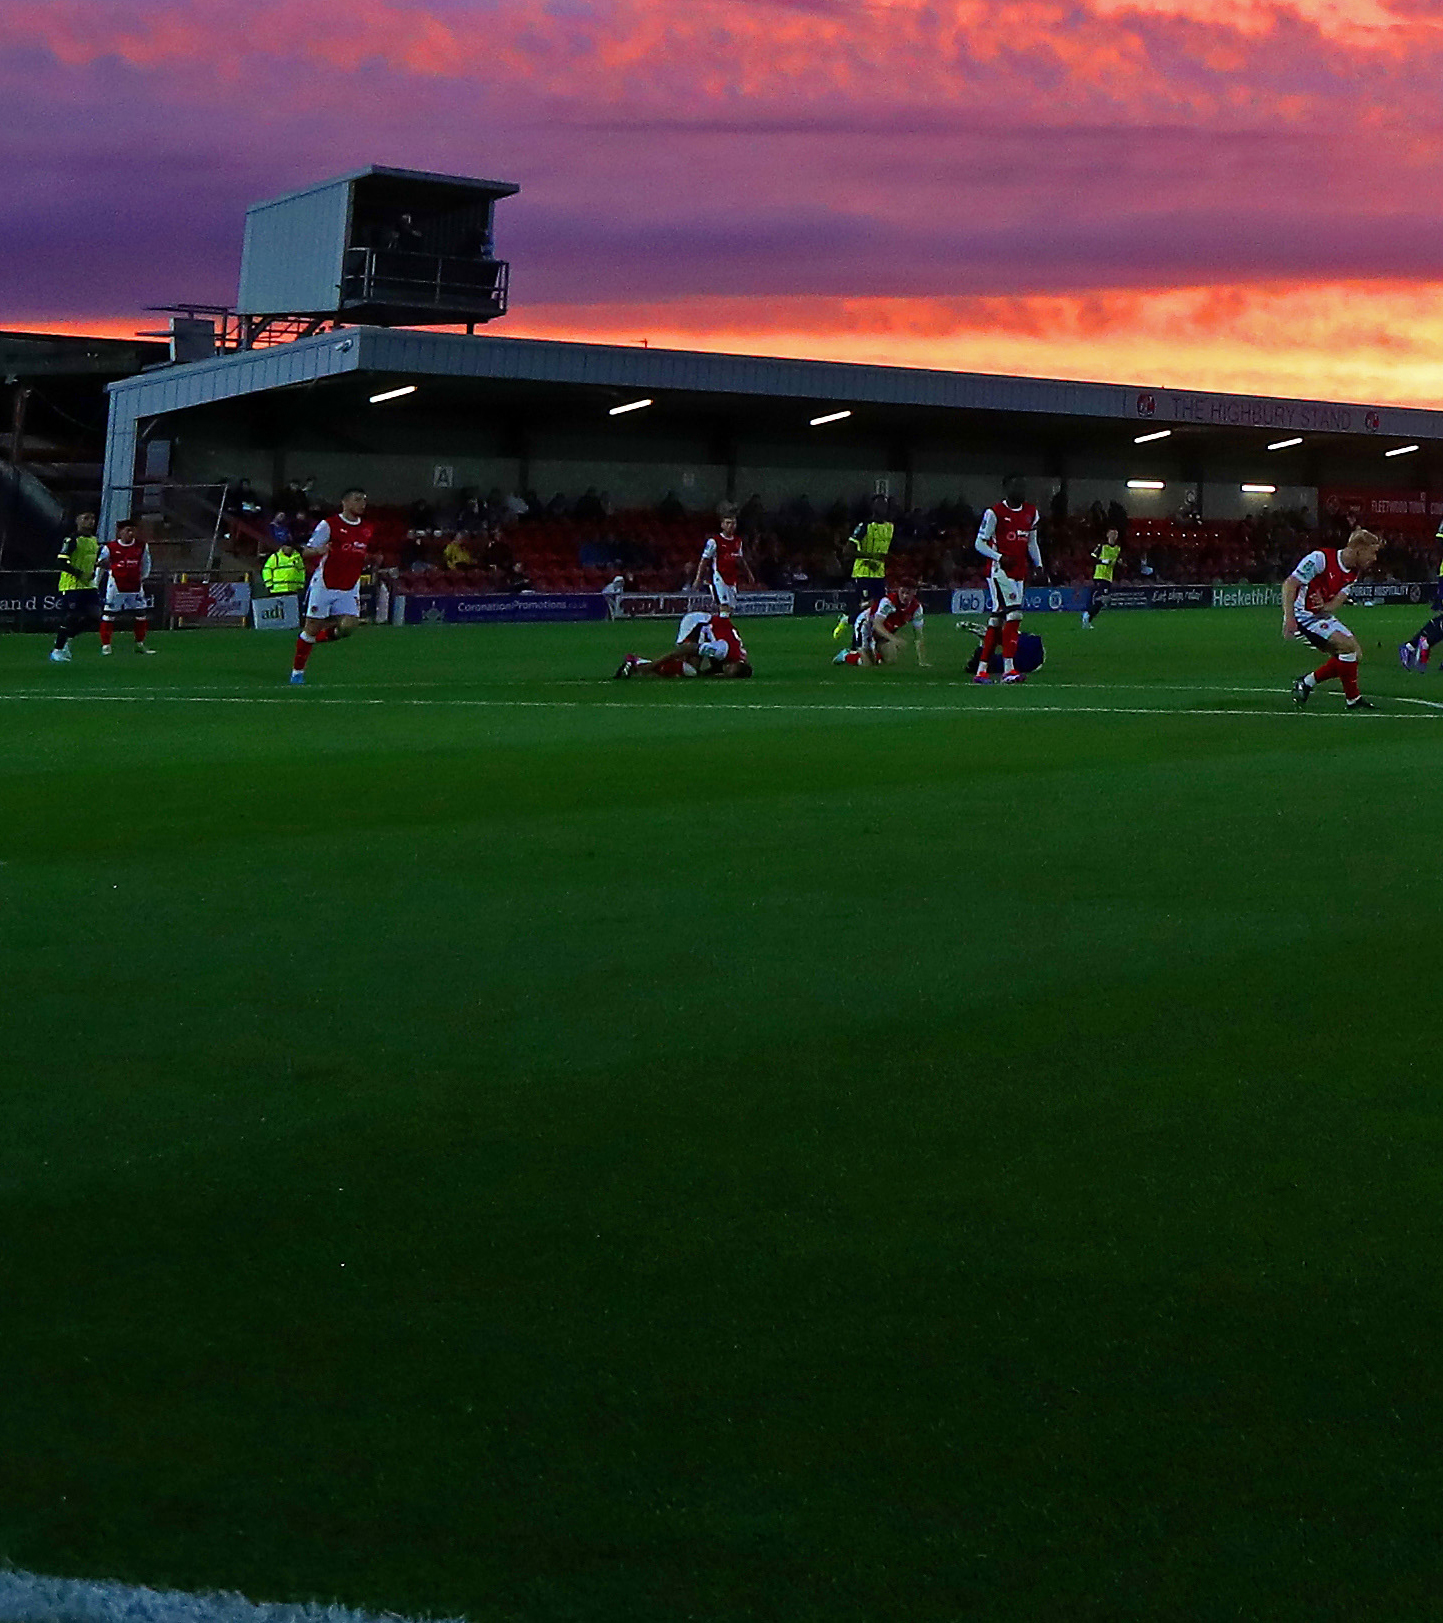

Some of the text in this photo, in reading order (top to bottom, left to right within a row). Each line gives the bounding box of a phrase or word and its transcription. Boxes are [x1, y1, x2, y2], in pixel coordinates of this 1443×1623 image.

[1171, 397, 1352, 431] THE HIGHBURY STAND
[815, 599, 848, 612] Choice
[1213, 588, 1282, 607] HeskethPre
[262, 601, 286, 621] adi
